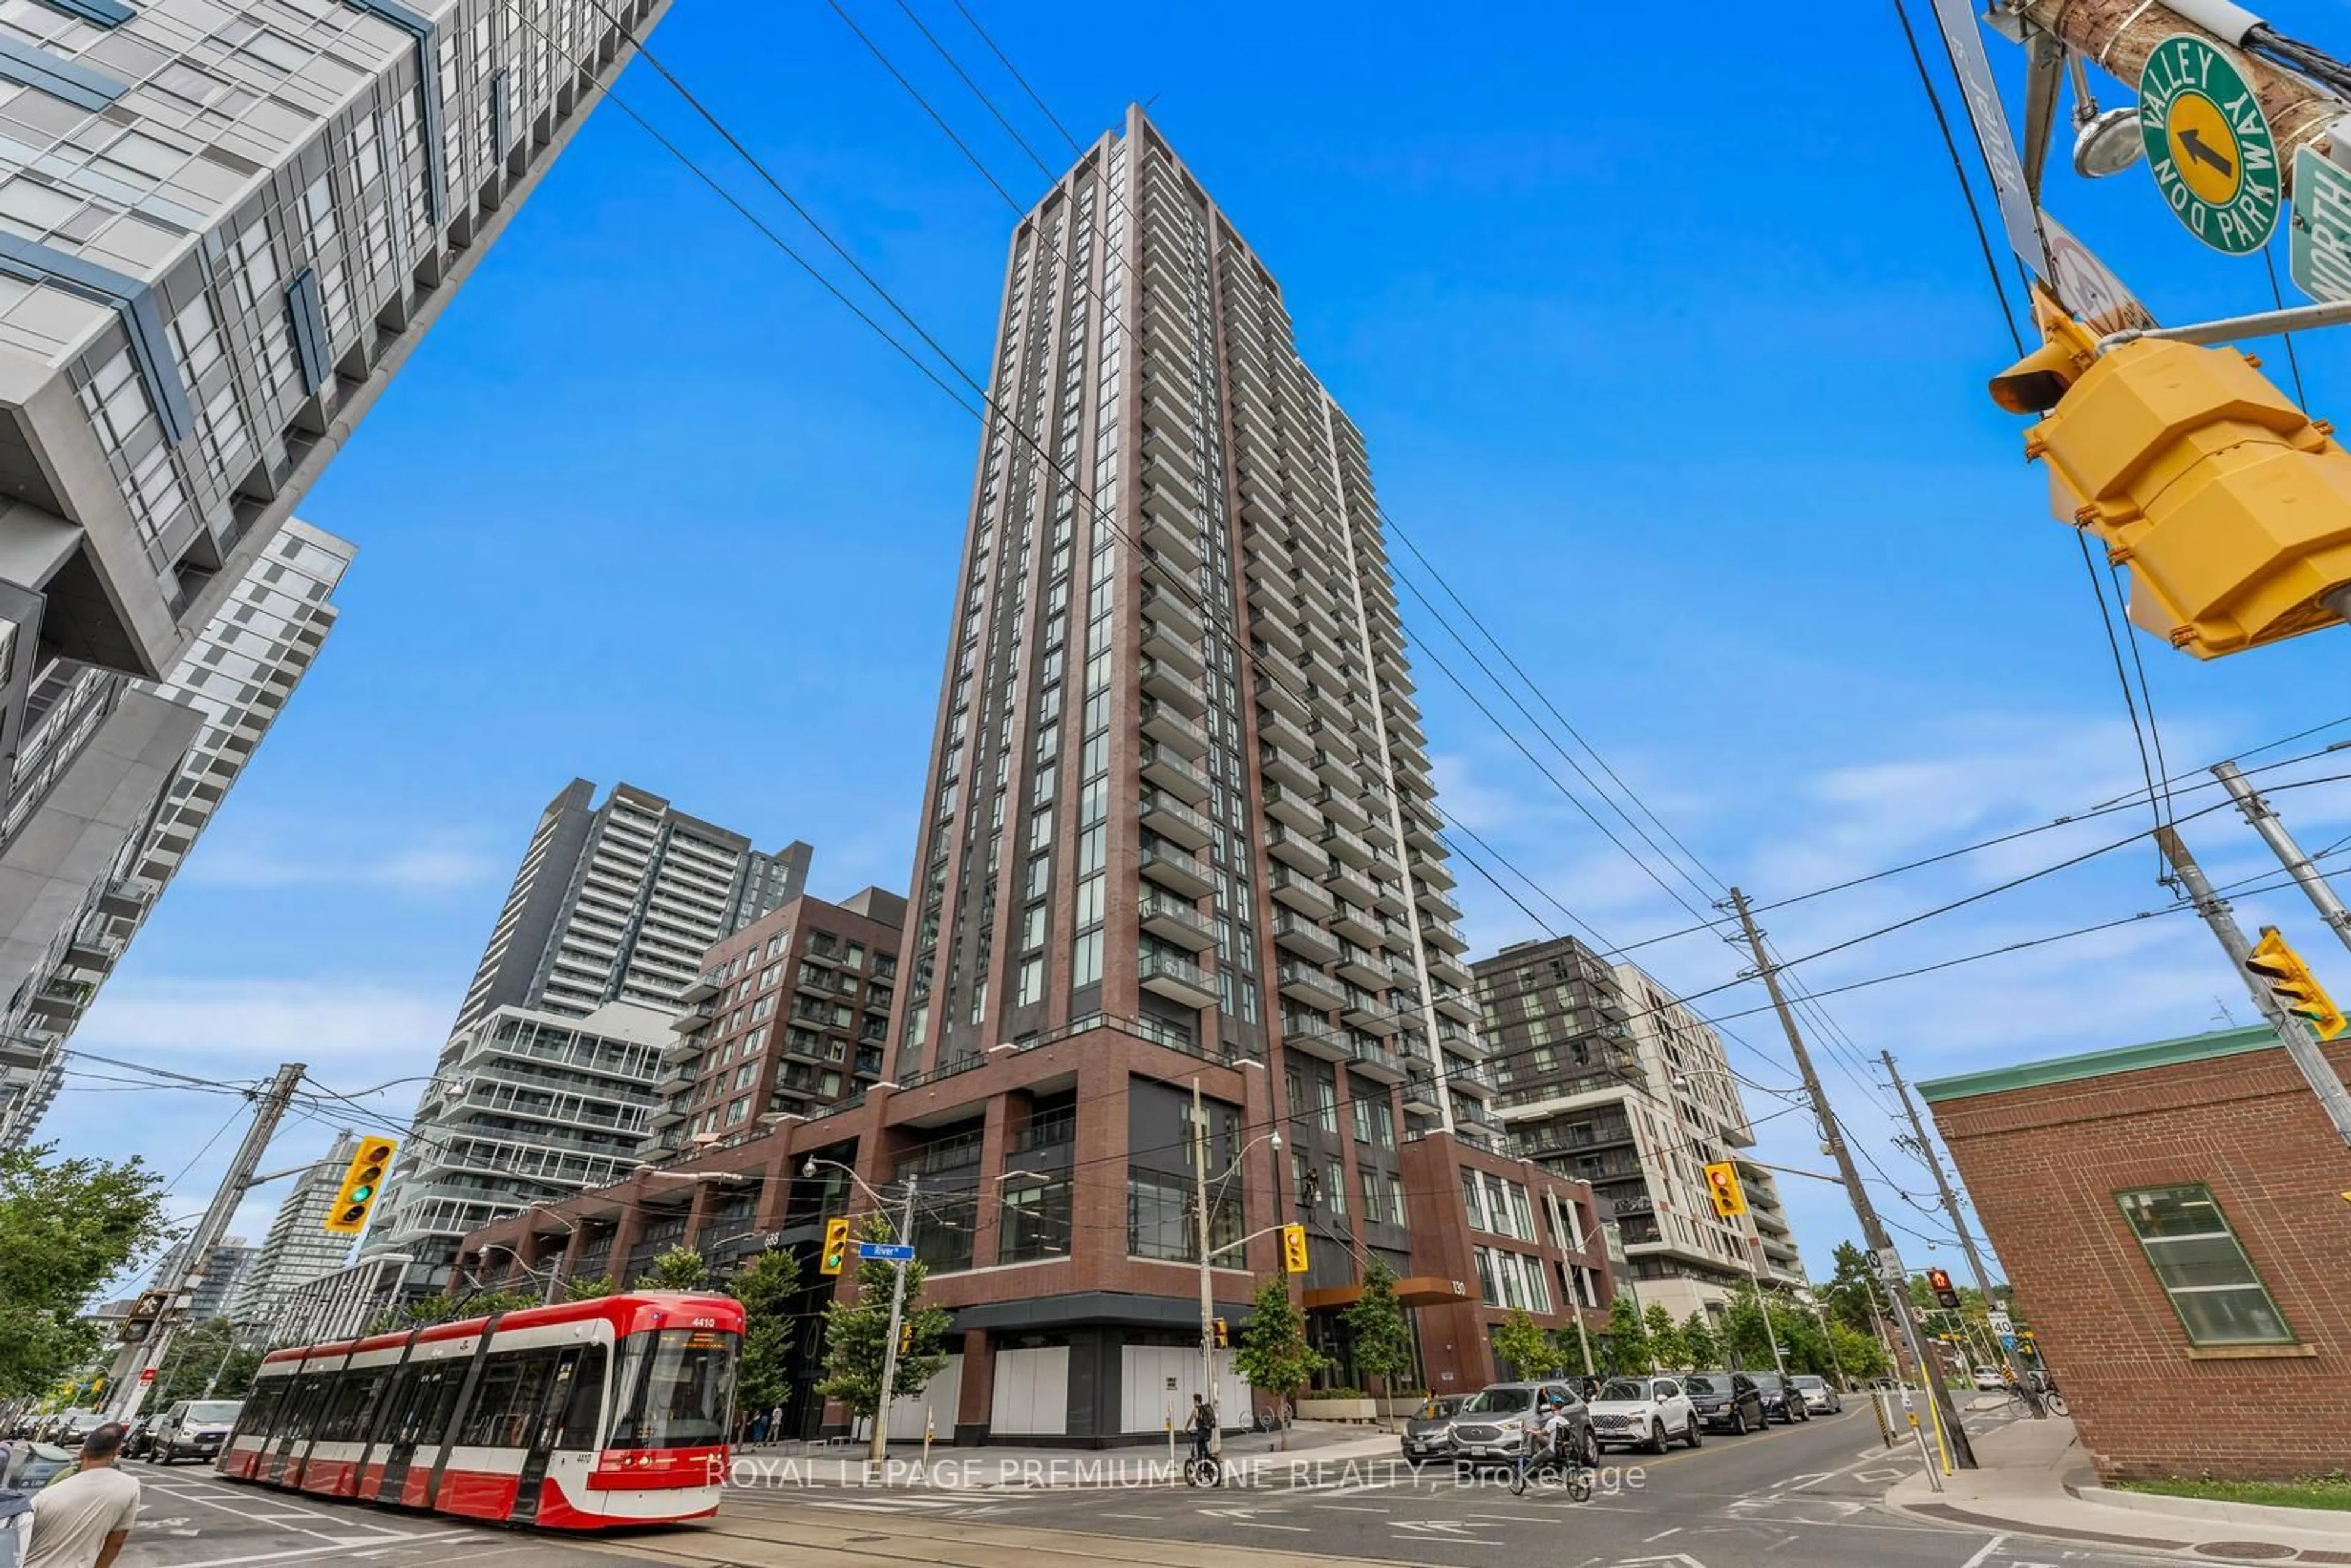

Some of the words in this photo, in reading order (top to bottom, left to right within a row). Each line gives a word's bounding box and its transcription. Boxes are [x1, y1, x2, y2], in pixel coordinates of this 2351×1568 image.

[2143, 42, 2214, 130] VALLEY
[1966, 70, 2019, 194] River
[2216, 91, 2275, 249] PARKWAY
[2154, 157, 2207, 236] DON
[874, 1245, 894, 1256] River
[1452, 1280, 1466, 1297] 130
[692, 1317, 716, 1328] 4410
[1995, 1322, 2011, 1333] 40
[577, 1453, 592, 1464] 4410
